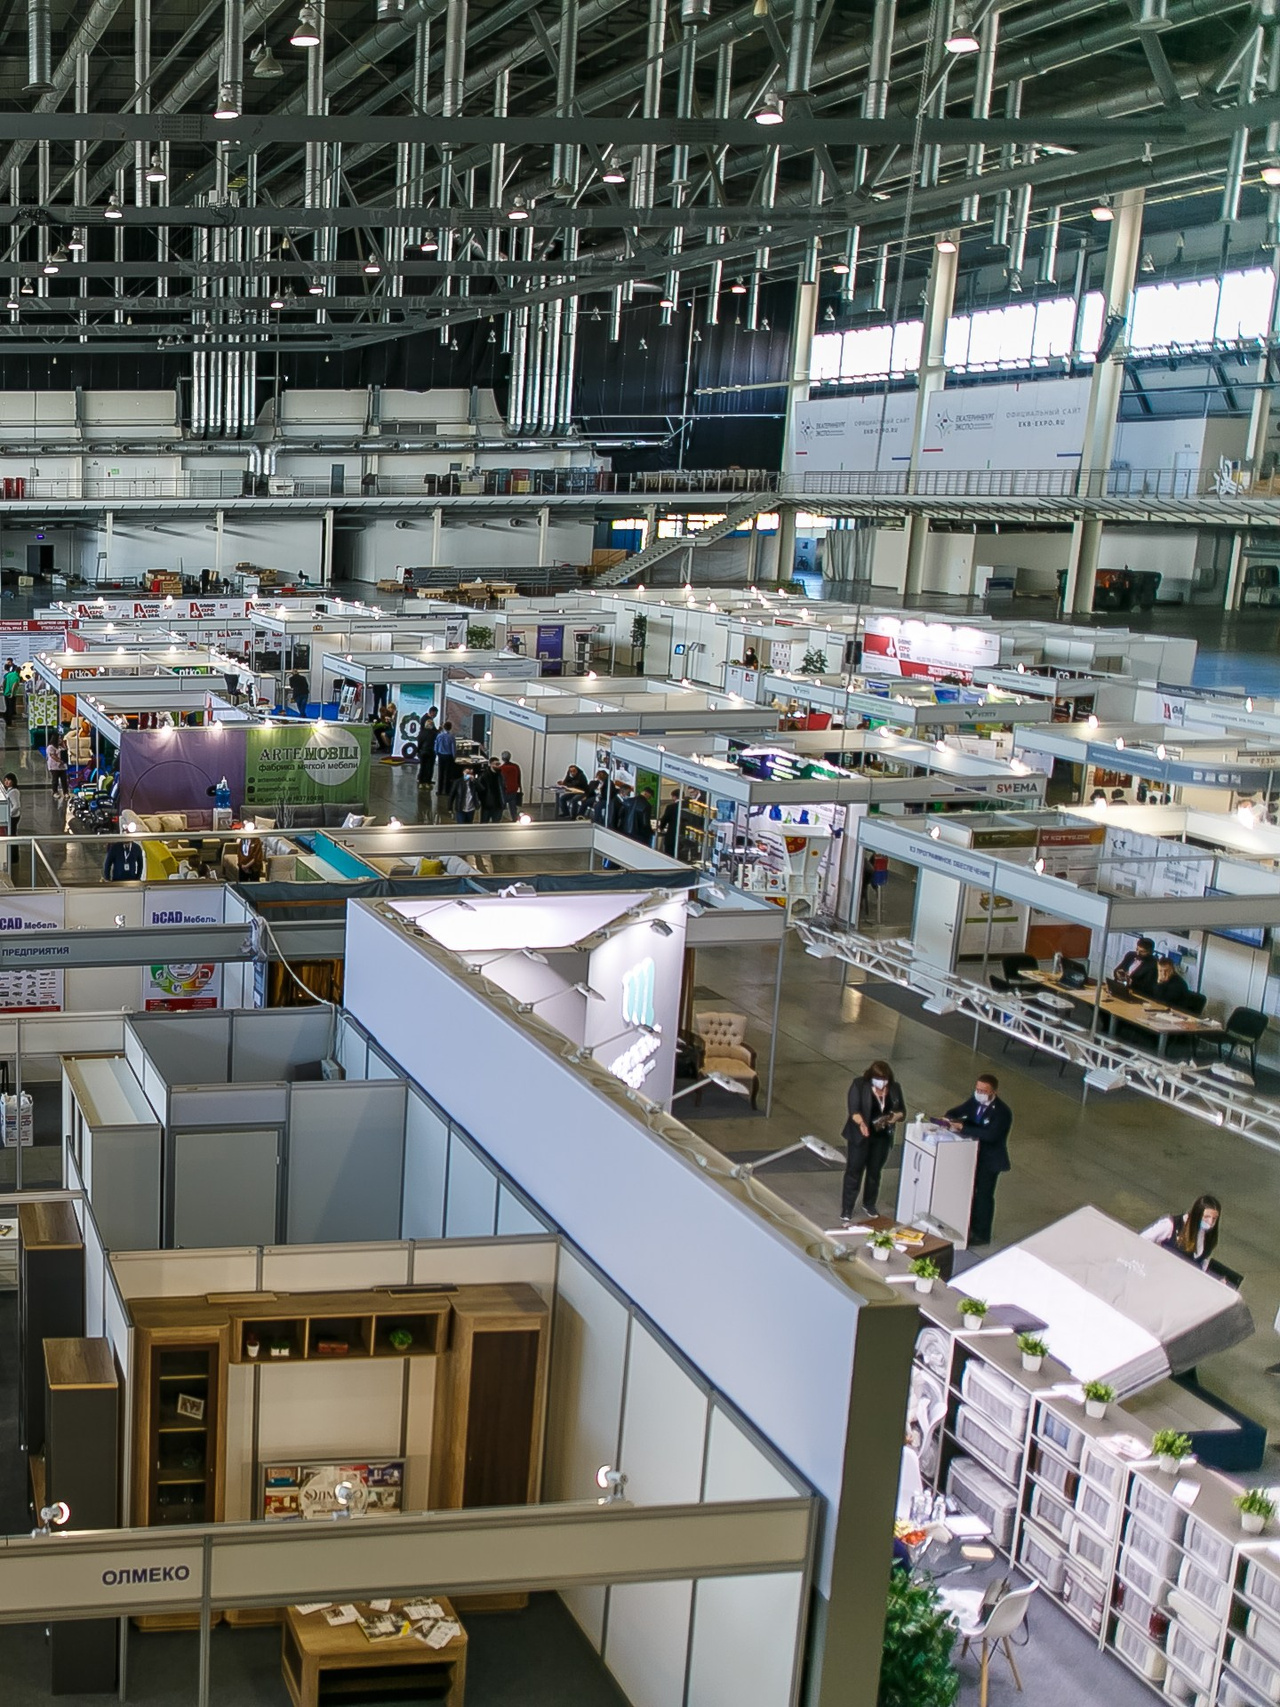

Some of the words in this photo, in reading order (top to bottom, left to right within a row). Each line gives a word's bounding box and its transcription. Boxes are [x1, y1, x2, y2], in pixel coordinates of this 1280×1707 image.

[955, 413, 995, 422] ЕКАТЕРИНБУРГ
[1018, 419, 1066, 428] EKB-EXPO.RU
[68, 668, 90, 679] ntko
[179, 667, 202, 676] ntko
[259, 746, 359, 760] ARTEMOBILI
[258, 764, 296, 773] фабрика
[297, 762, 326, 770] мягкой
[327, 761, 359, 770] мебели
[996, 782, 1038, 794] SWEMA
[152, 911, 183, 924] bCAD
[183, 914, 217, 924] Мебель
[24, 921, 58, 930] Мебель
[1, 946, 70, 957] ПРЕДПРИЯТИЯ
[101, 1565, 190, 1586] ОЛМЕКО
